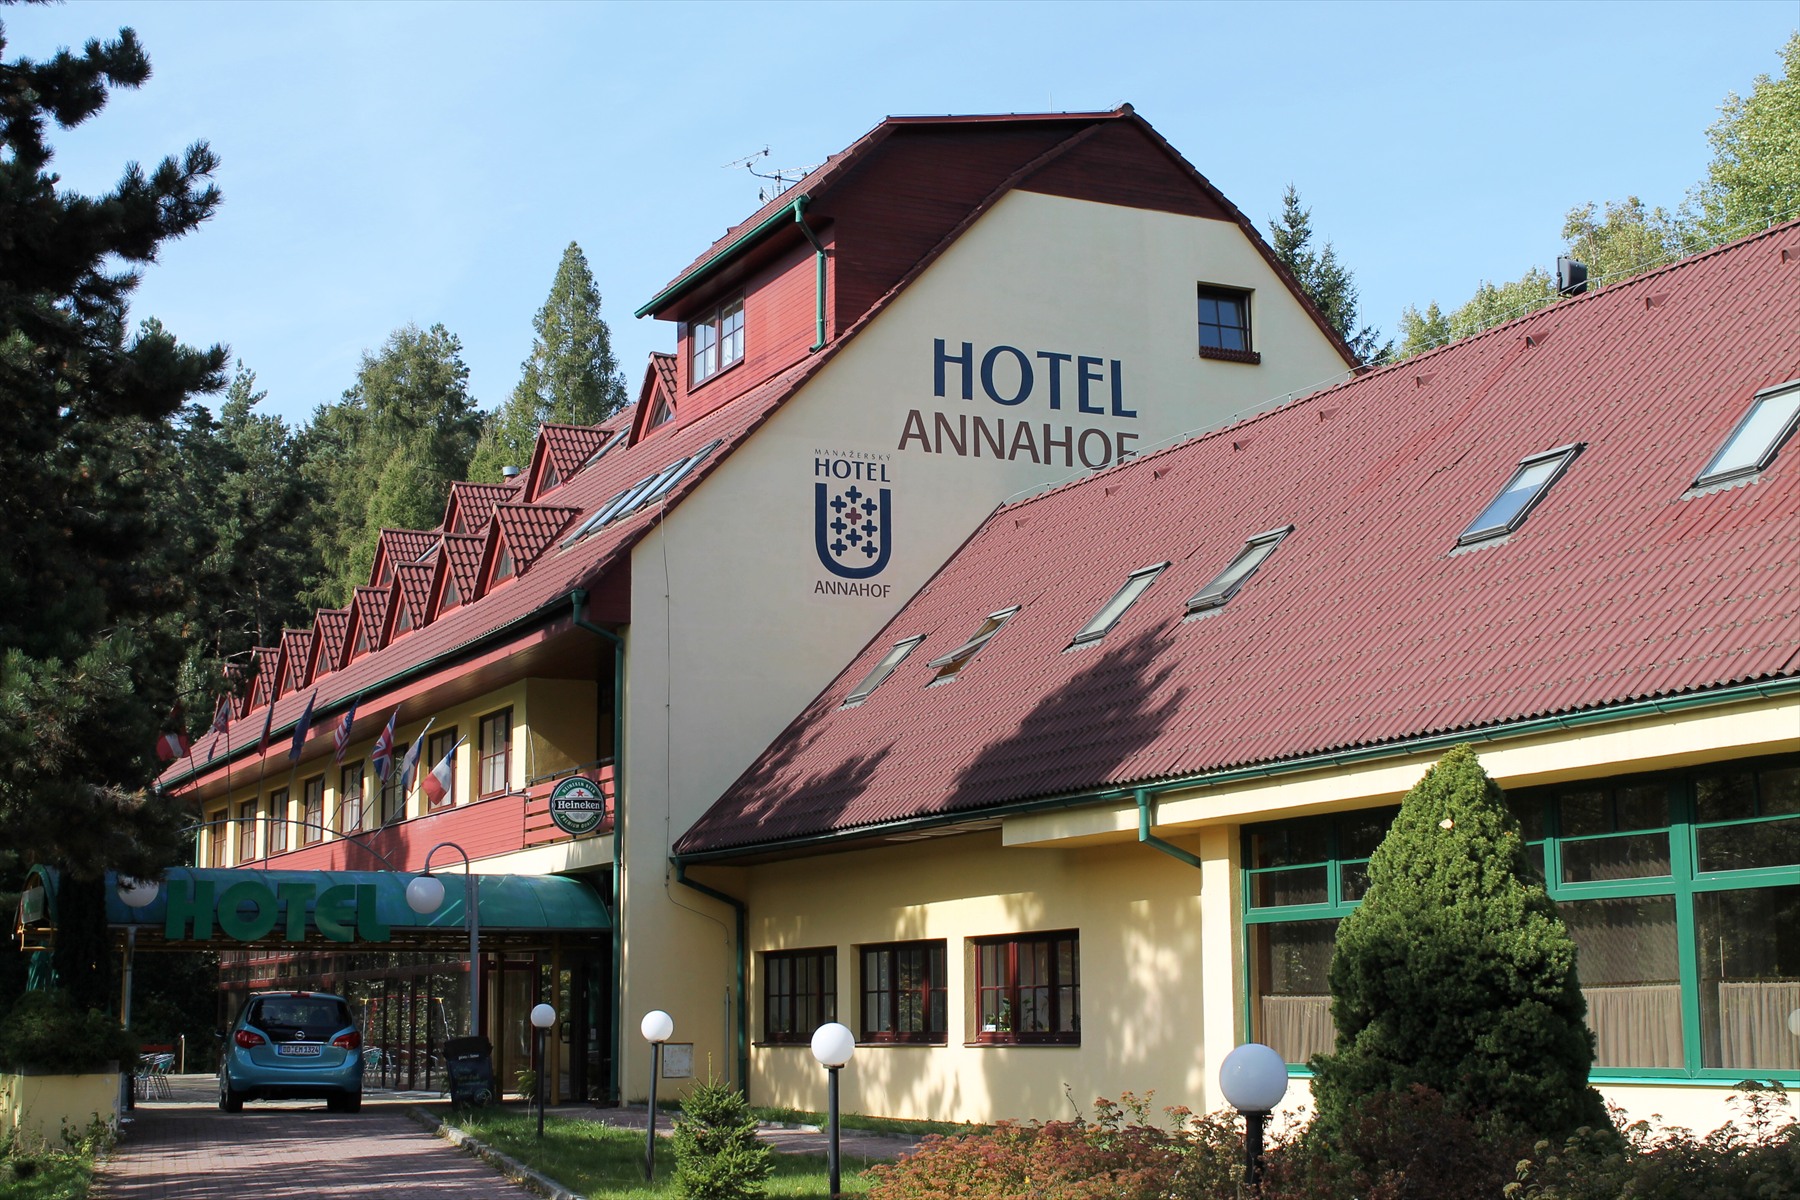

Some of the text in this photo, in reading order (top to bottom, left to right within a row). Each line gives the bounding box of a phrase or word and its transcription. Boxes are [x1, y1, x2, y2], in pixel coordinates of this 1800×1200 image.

[933, 337, 1138, 419] HOTEL
[897, 409, 1139, 471] ANNAHOF
[814, 448, 891, 461] MANAŽERSKÝ
[814, 457, 891, 483] HOTEL
[814, 580, 891, 598] ANNAHOF
[557, 800, 601, 810] Heineken
[164, 879, 391, 943] HOTEL
